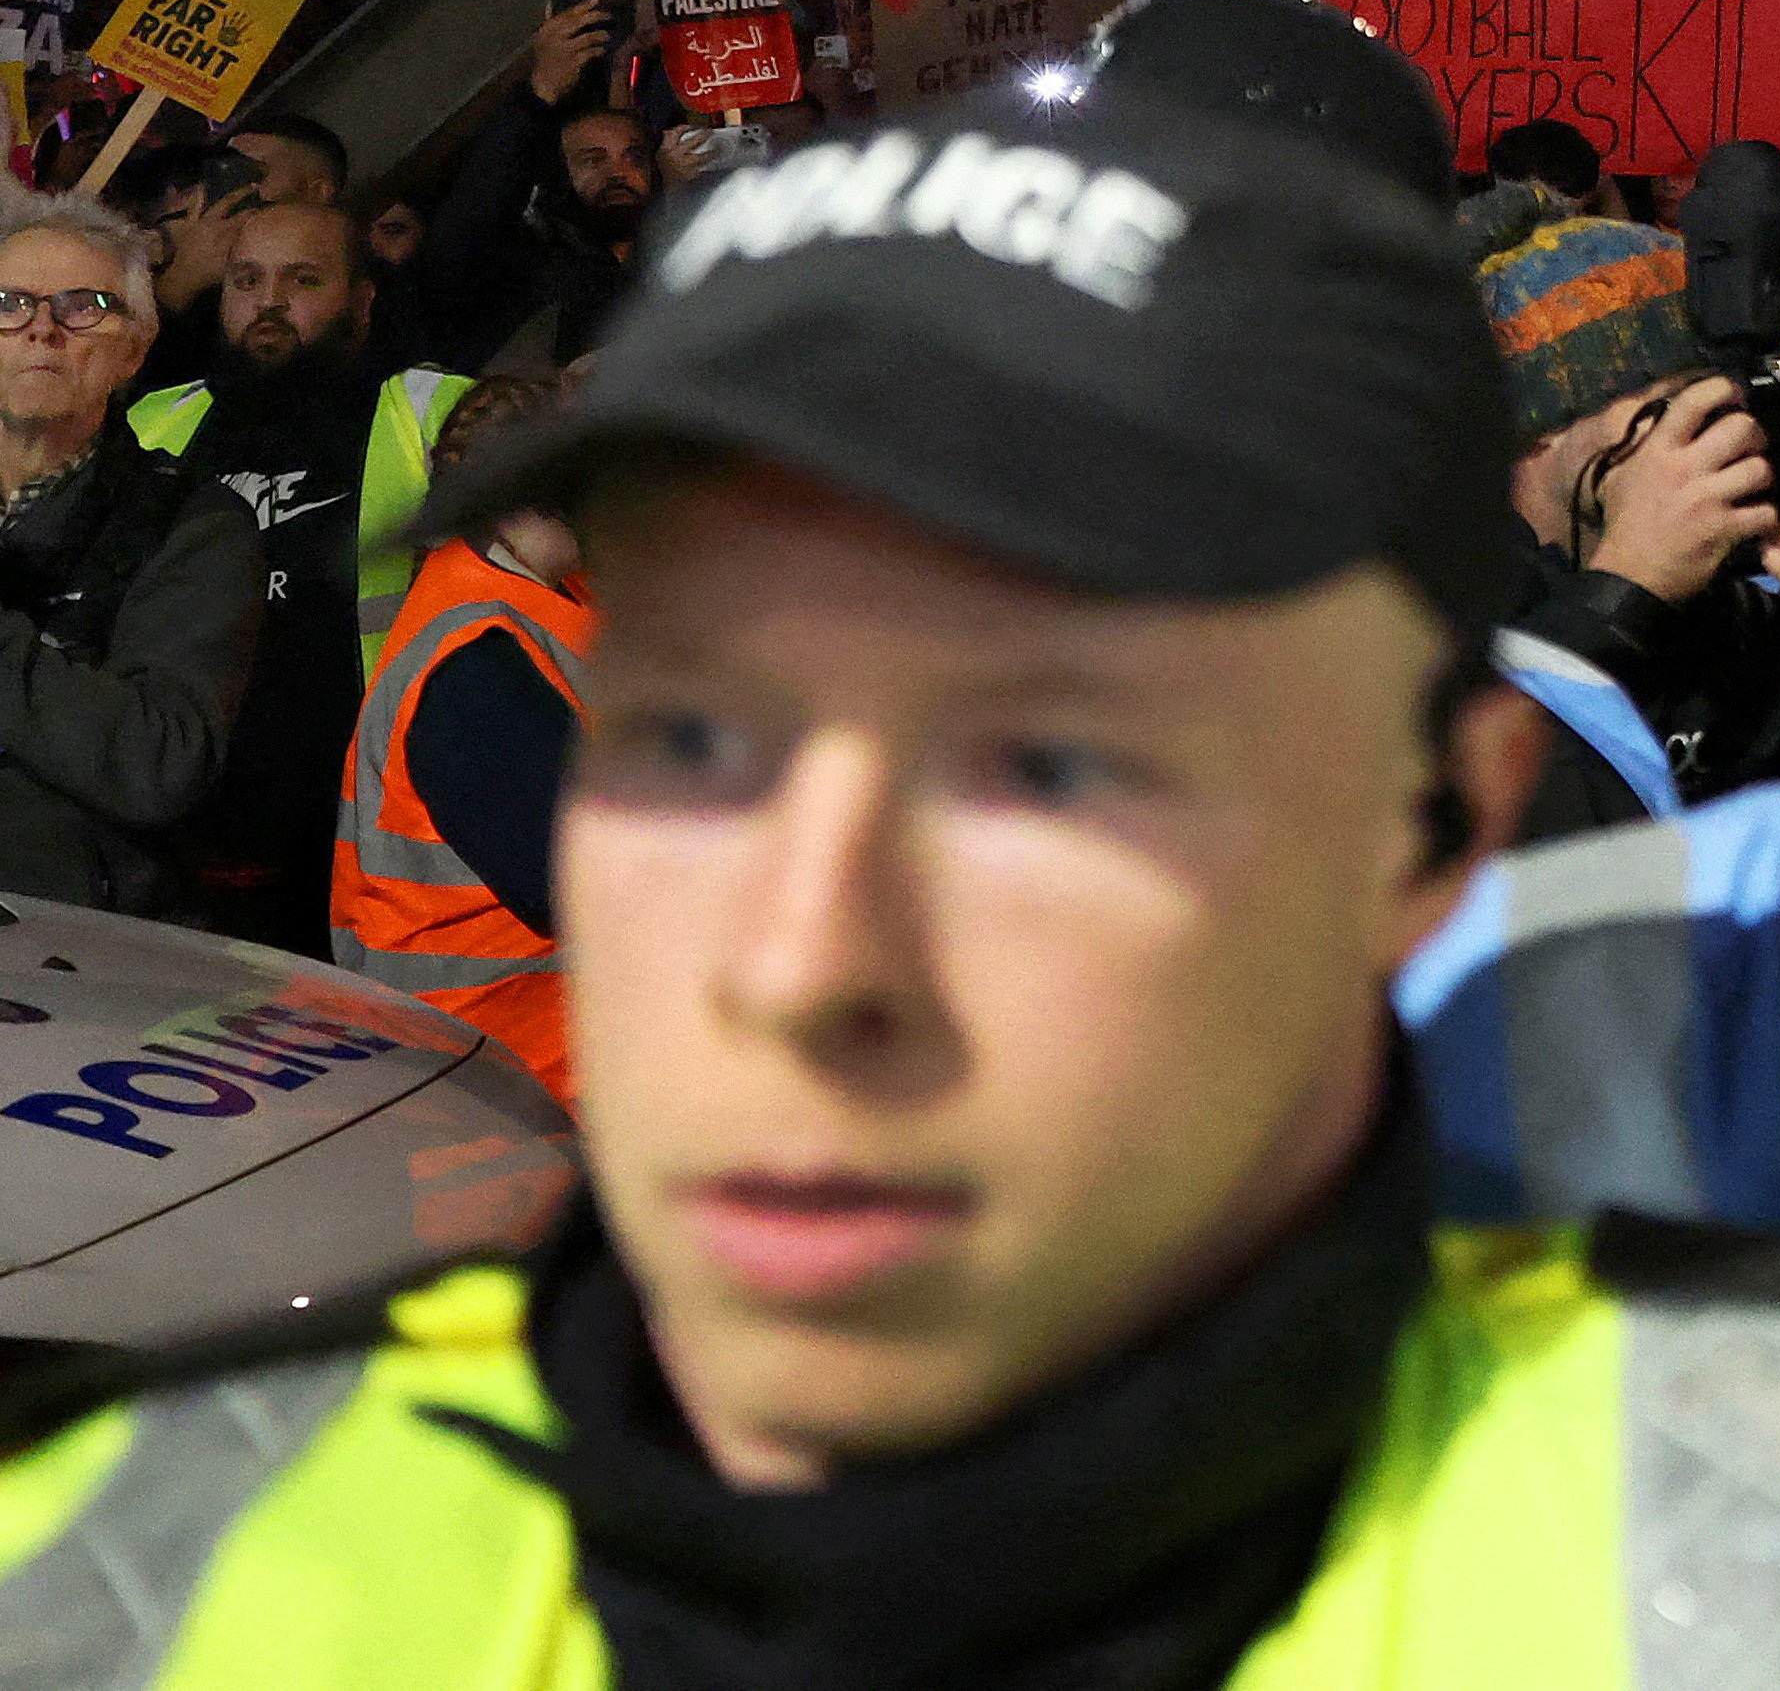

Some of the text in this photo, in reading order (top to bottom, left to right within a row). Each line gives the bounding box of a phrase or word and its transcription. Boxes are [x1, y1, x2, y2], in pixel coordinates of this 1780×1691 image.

[129, 12, 240, 80] RIGHT
[685, 24, 763, 60] الحرية
[683, 56, 781, 97] لفلسطين
[656, 126, 1194, 313] POLICE
[266, 570, 288, 601] R
[0, 1005, 399, 1159] POLICE
